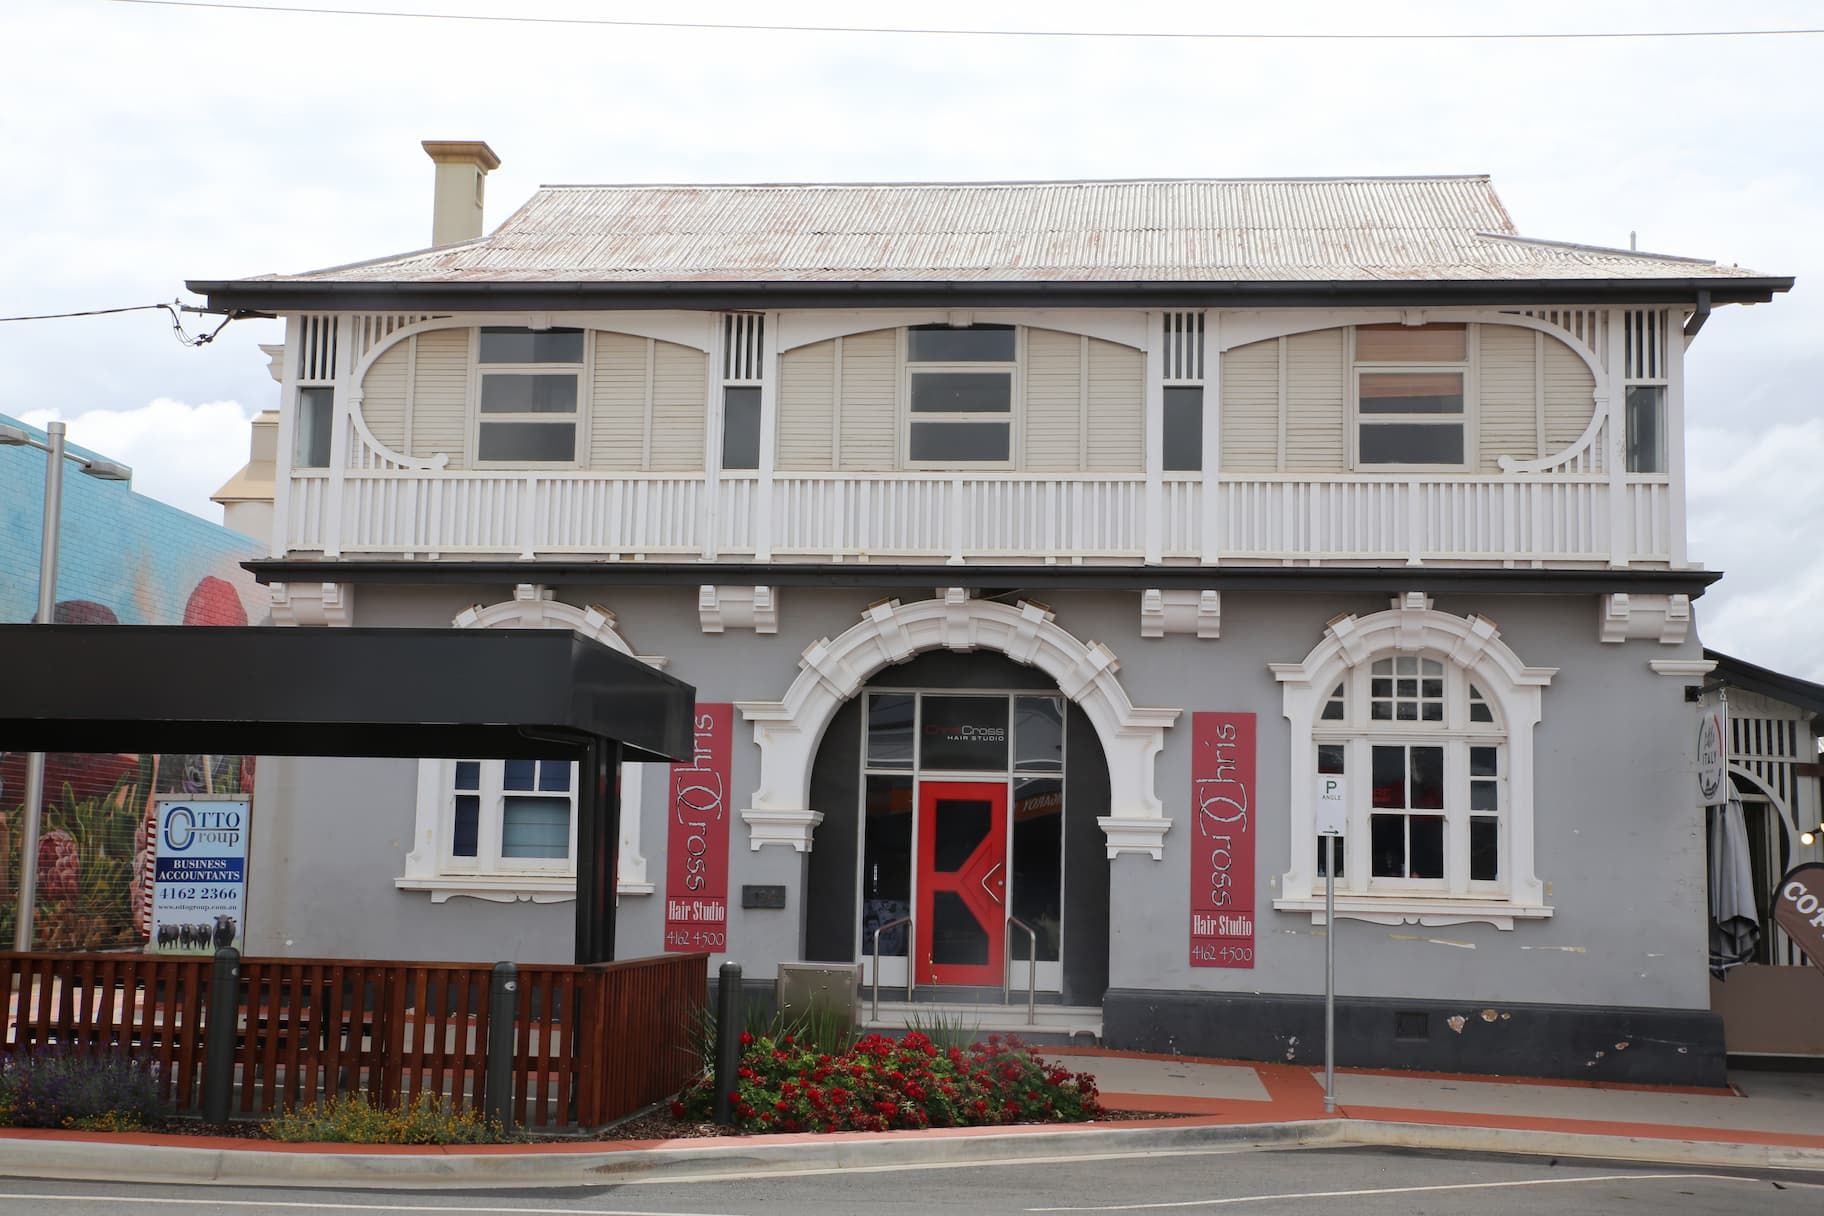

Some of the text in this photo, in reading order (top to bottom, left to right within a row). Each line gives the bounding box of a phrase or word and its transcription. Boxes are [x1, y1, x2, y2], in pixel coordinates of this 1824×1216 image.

[961, 725, 1005, 736] Cross
[1326, 780, 1337, 794] P
[173, 860, 227, 869] BUSINESS
[158, 870, 240, 881] ACCOUNTANTS
[159, 887, 237, 900] 4162 2366
[668, 900, 725, 922] Hair Studio
[1193, 914, 1252, 937] Hair Studio
[666, 928, 725, 948] 4162 4500
[1191, 944, 1253, 965] 4162 4500
